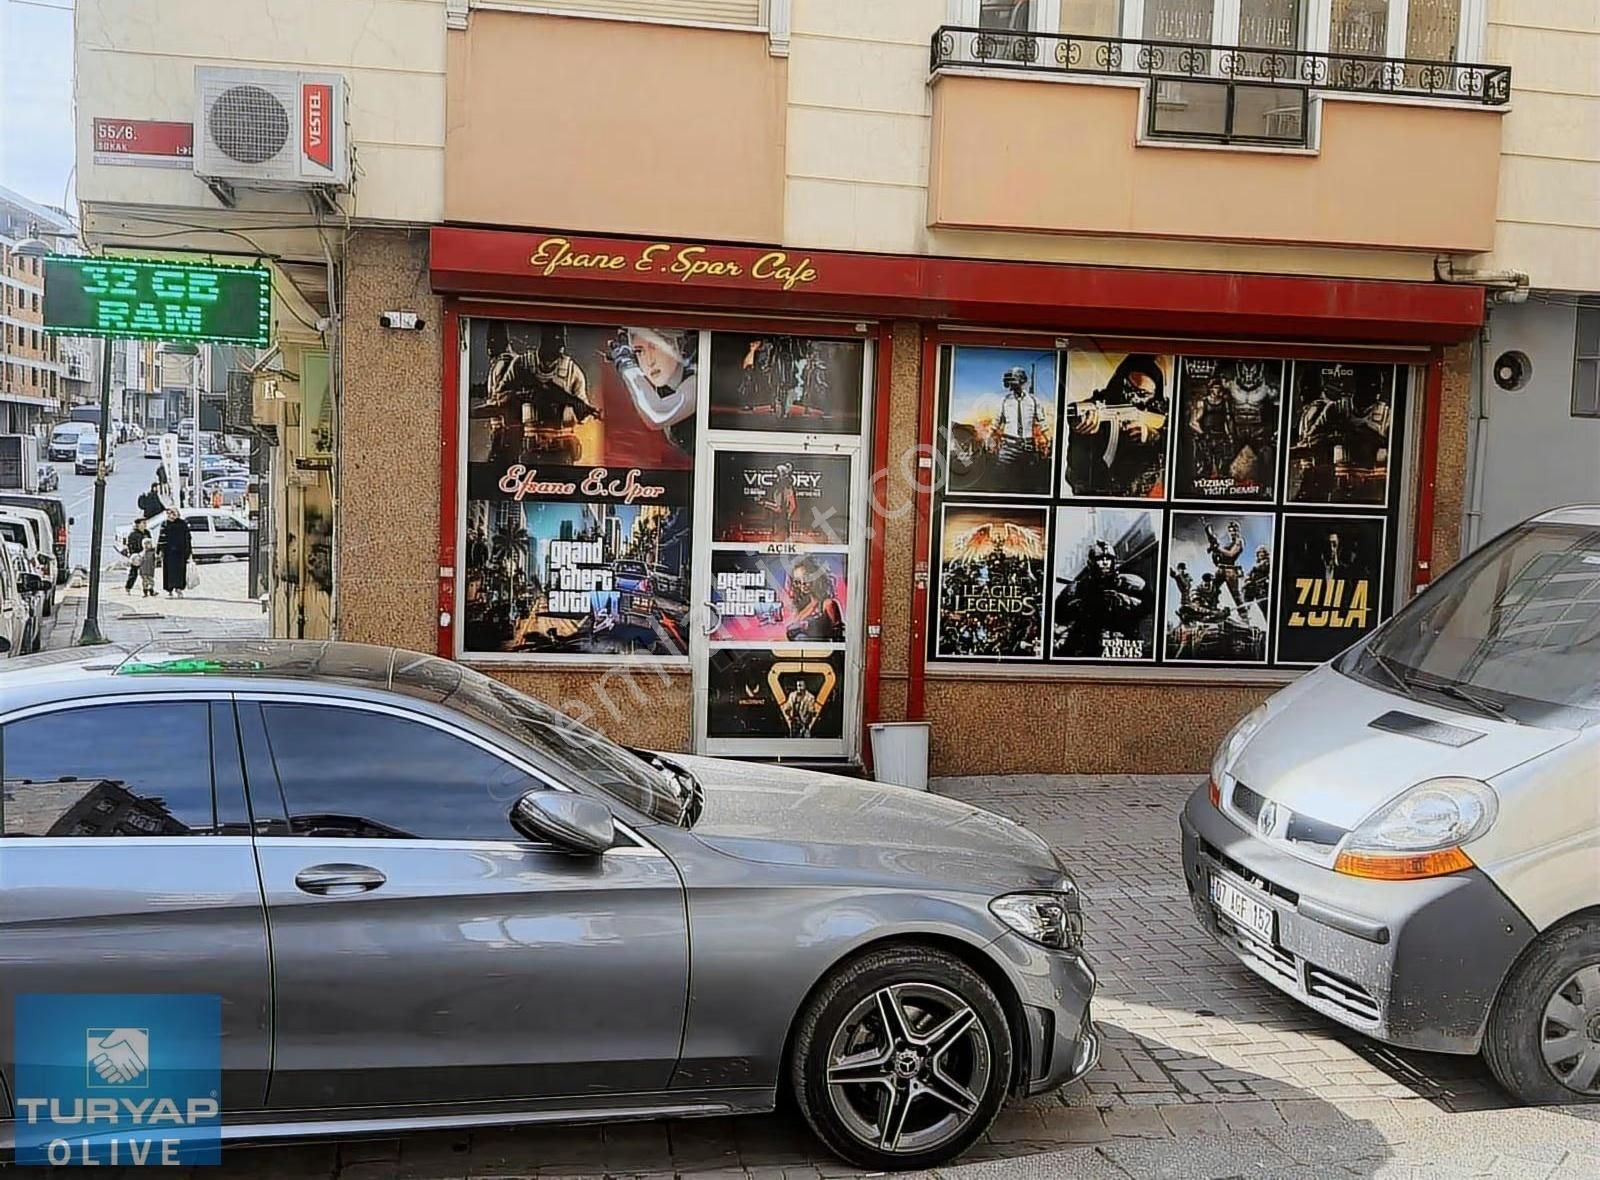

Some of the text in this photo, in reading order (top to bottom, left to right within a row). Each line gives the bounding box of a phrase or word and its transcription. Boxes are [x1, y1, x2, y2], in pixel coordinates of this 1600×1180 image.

[309, 91, 321, 147] VESTEL
[530, 238, 626, 276] Efsane
[751, 252, 817, 290] Cafe
[81, 265, 220, 301] 32 GB
[98, 300, 202, 332] RAM
[499, 464, 577, 501] Efsane
[743, 473, 822, 488] VICRY
[550, 537, 603, 569] grand
[560, 564, 613, 591] theft
[717, 570, 766, 590] grand
[963, 584, 1022, 598] LEAGUE
[548, 590, 591, 613] auto
[954, 595, 1037, 616] LEGENDS
[1287, 578, 1369, 628] ZULA
[1101, 647, 1143, 658] ARMS
